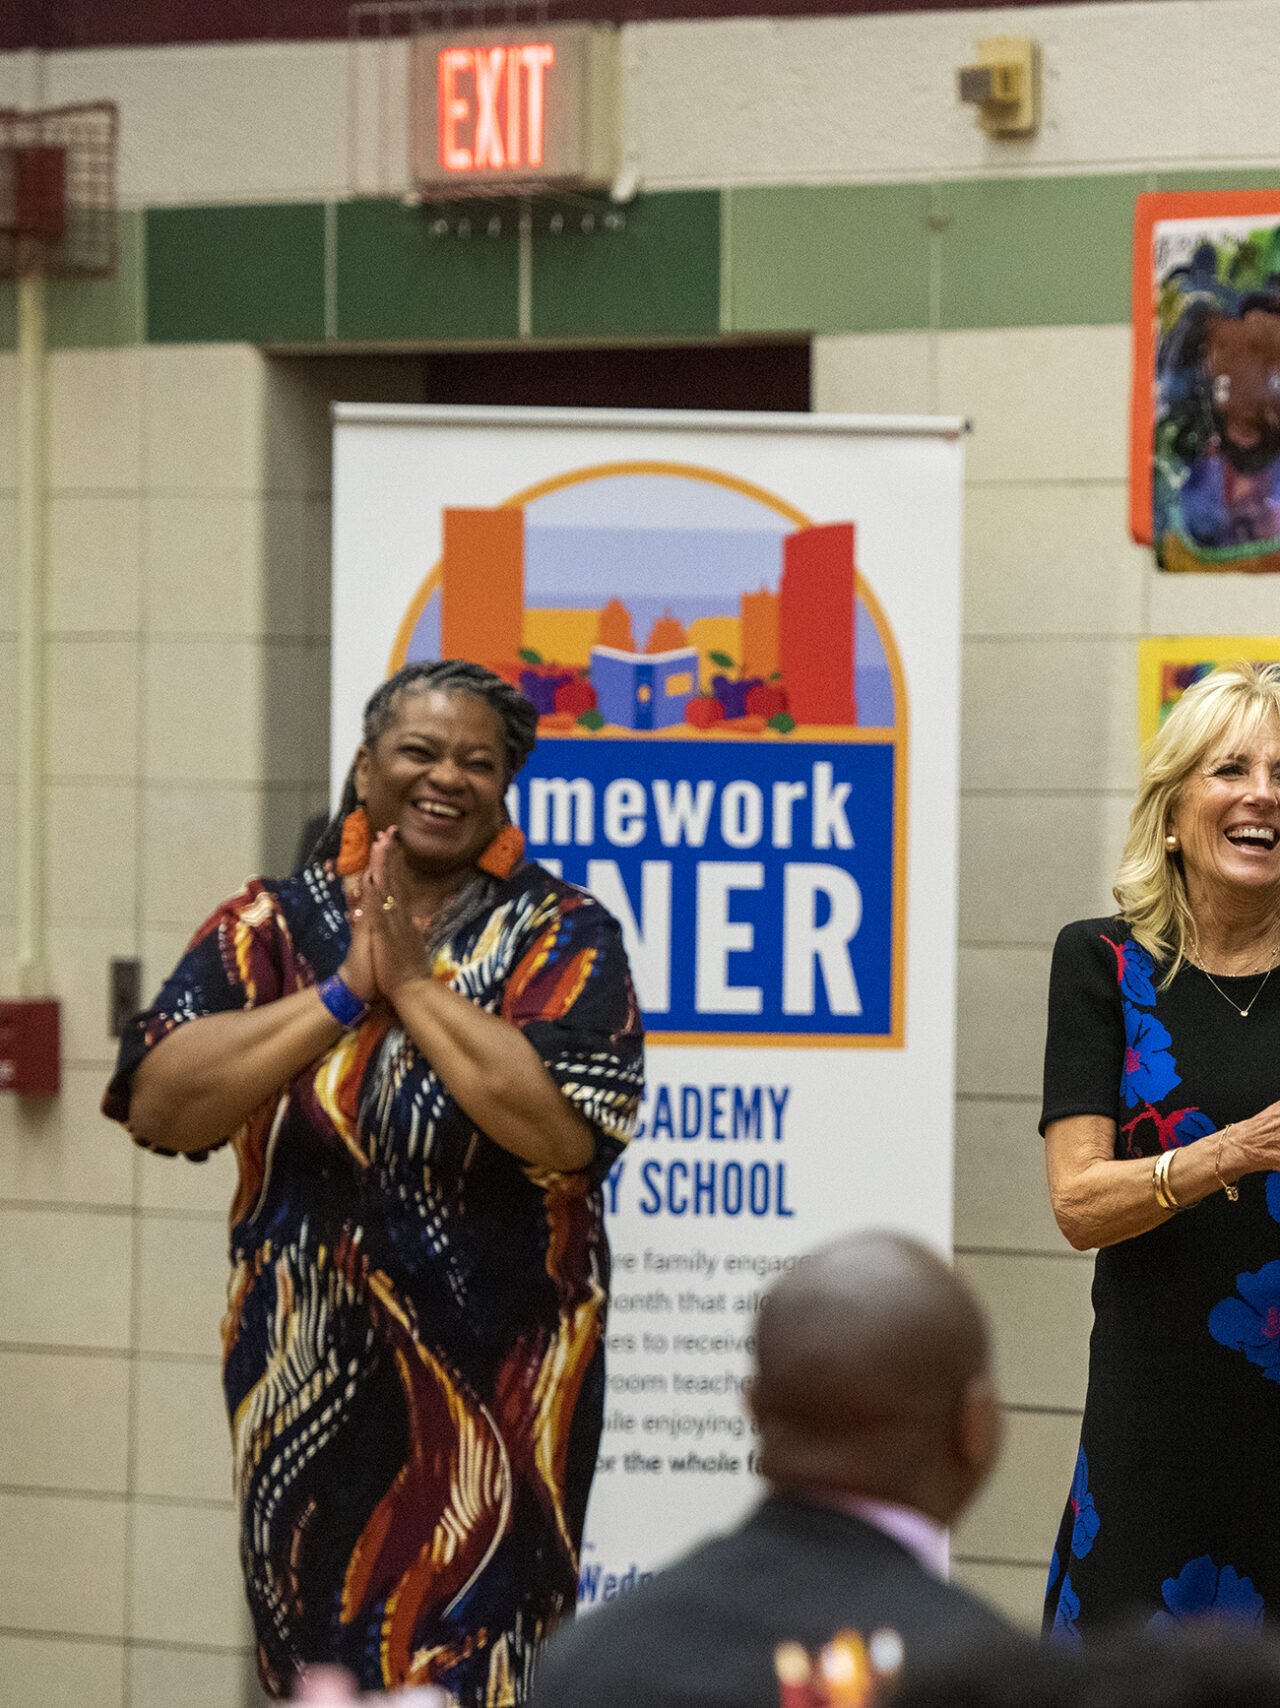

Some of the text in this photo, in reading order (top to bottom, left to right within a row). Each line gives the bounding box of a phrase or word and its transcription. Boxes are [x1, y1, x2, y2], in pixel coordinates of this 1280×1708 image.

[438, 43, 556, 172] EXIT
[505, 761, 855, 850] mework
[533, 858, 863, 1017] NER
[640, 1160, 794, 1217] SCHOOL
[643, 1248, 719, 1279] family
[724, 1254, 808, 1277] engage
[613, 1290, 673, 1313] onth
[678, 1290, 727, 1313] that
[607, 1334, 637, 1354] es
[642, 1331, 669, 1354] to
[607, 1409, 636, 1433] ile
[641, 1412, 745, 1440] enjoying
[623, 1450, 663, 1474] the
[667, 1450, 742, 1474] whole
